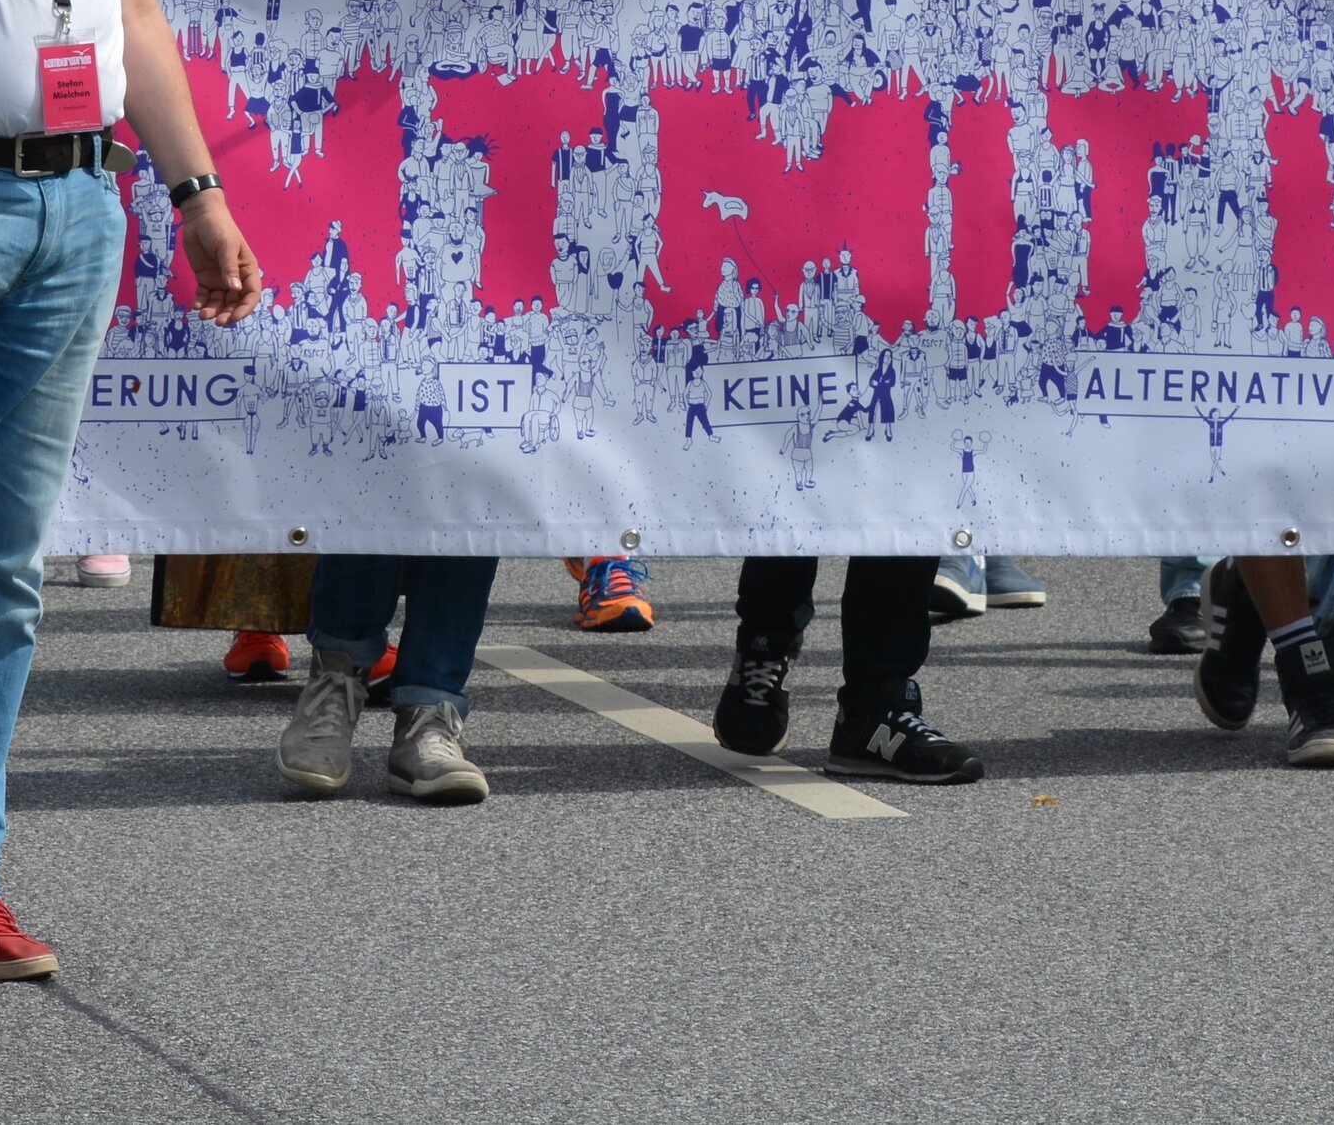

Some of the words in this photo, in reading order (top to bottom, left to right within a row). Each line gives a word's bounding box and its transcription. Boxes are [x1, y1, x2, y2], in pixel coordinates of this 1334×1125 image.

[53, 90, 90, 100] Mielchen
[57, 80, 84, 89] Stefan
[645, 58, 1209, 344] MIT
[457, 378, 515, 413] IST
[723, 372, 837, 411] KEINE
[867, 724, 906, 761] N
